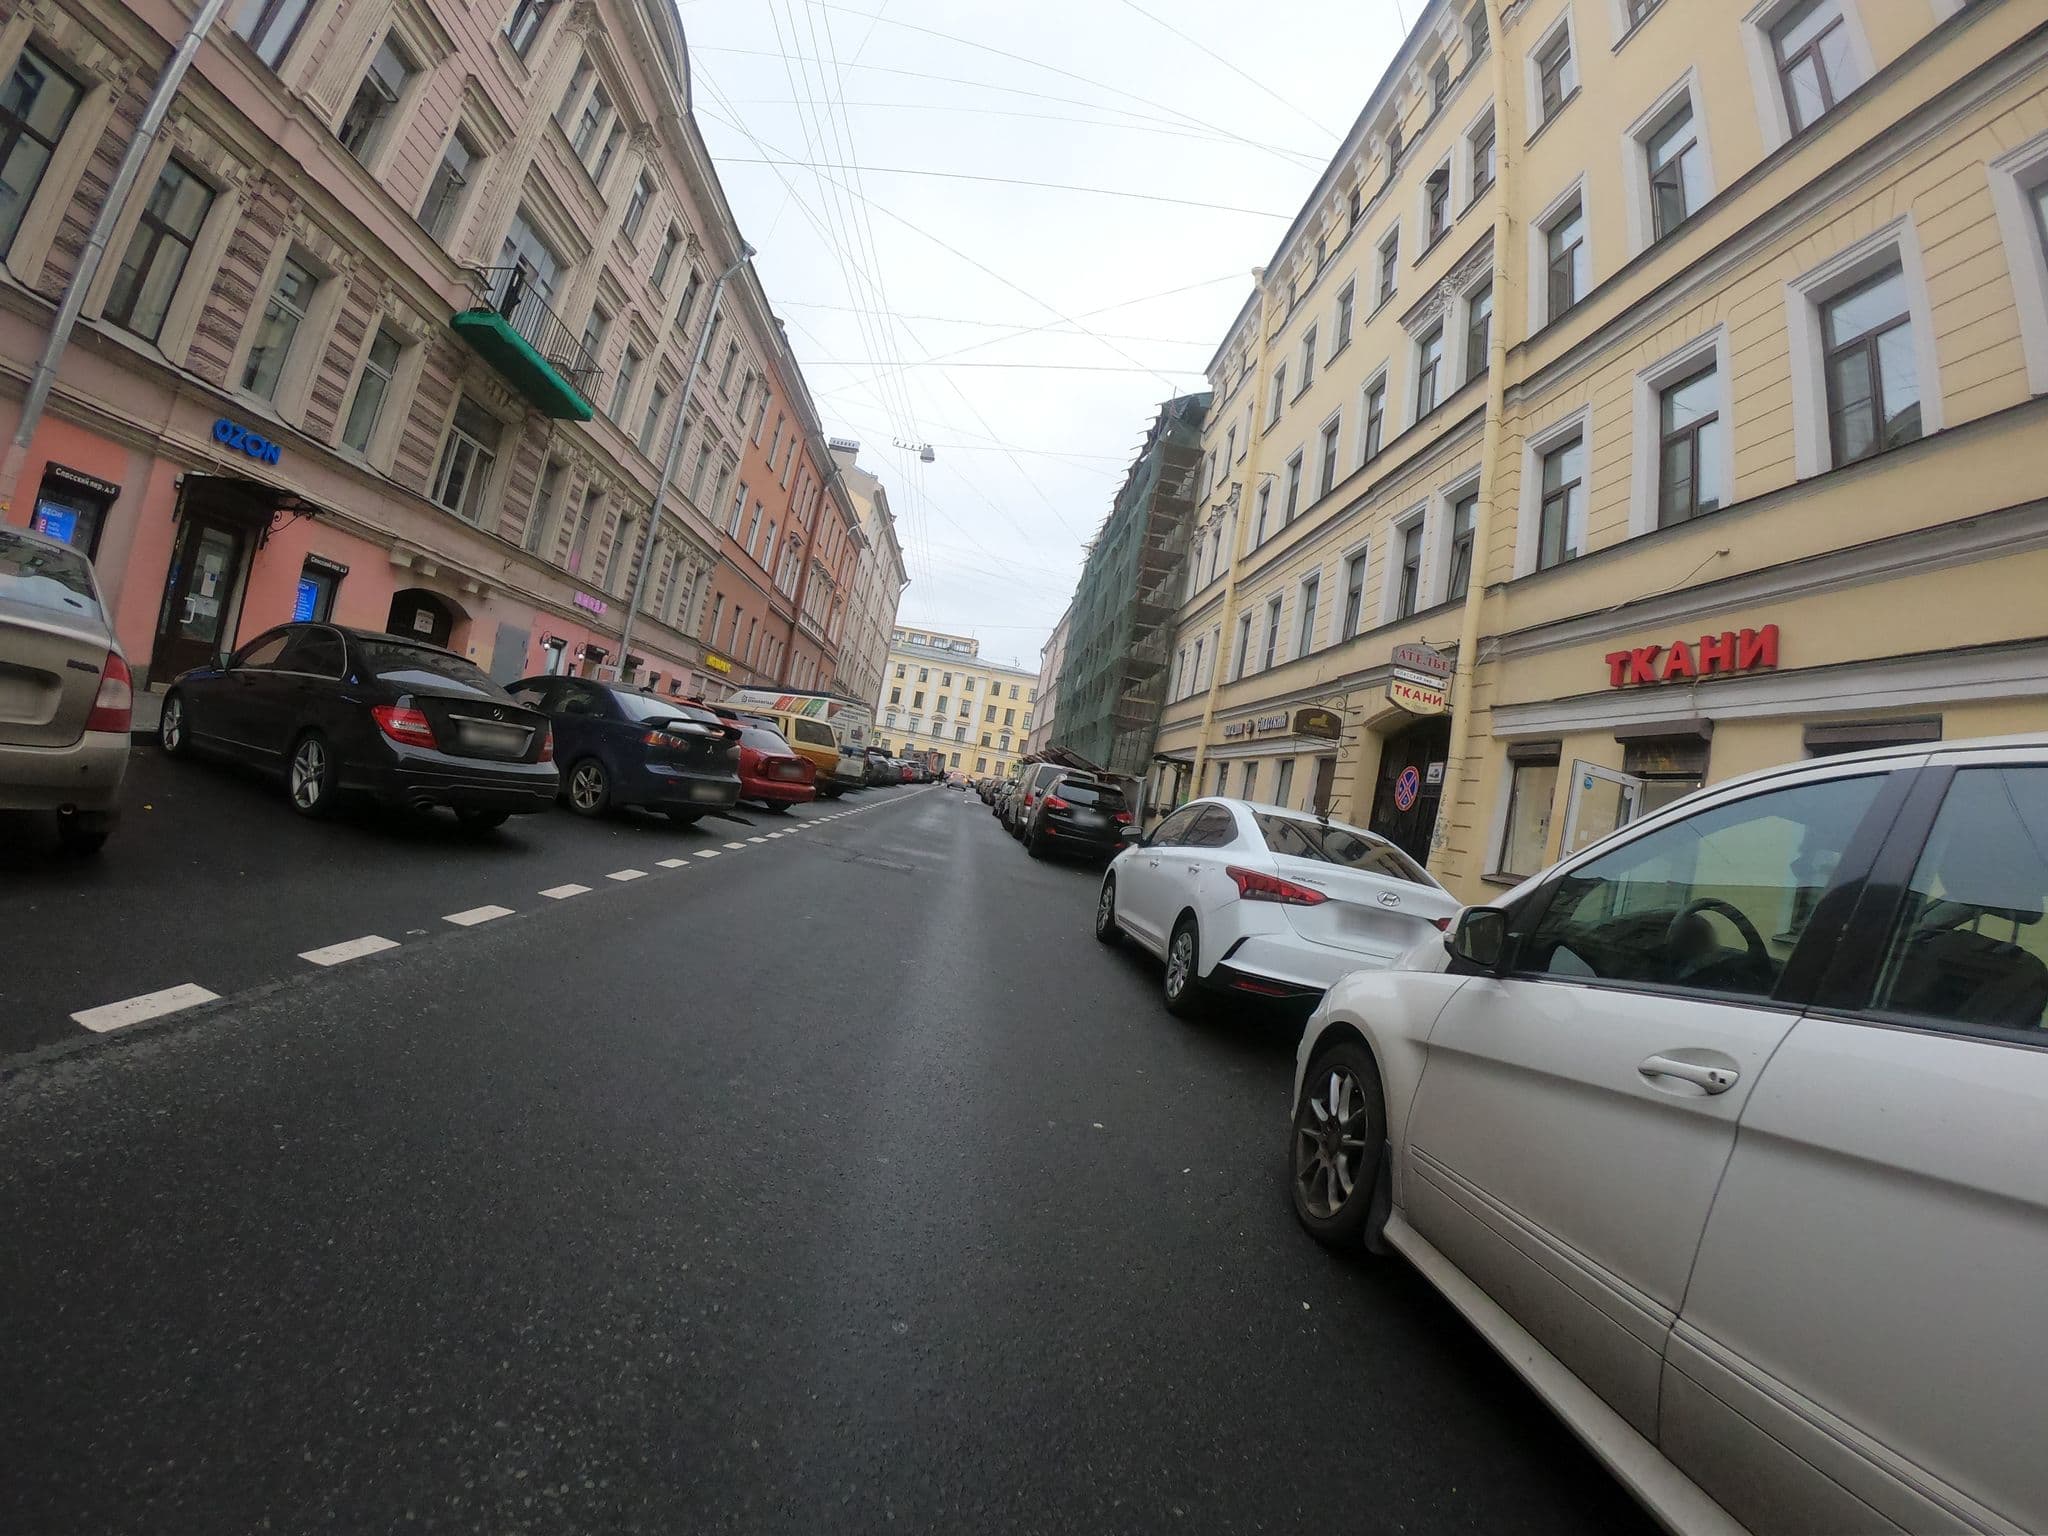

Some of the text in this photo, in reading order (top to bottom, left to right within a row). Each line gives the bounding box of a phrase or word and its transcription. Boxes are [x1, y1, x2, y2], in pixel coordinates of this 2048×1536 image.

[212, 416, 282, 466] OZON
[55, 467, 89, 487] Спасский
[1605, 624, 1779, 687] ТКАНИ
[1395, 685, 1442, 706] ТКАНИ
